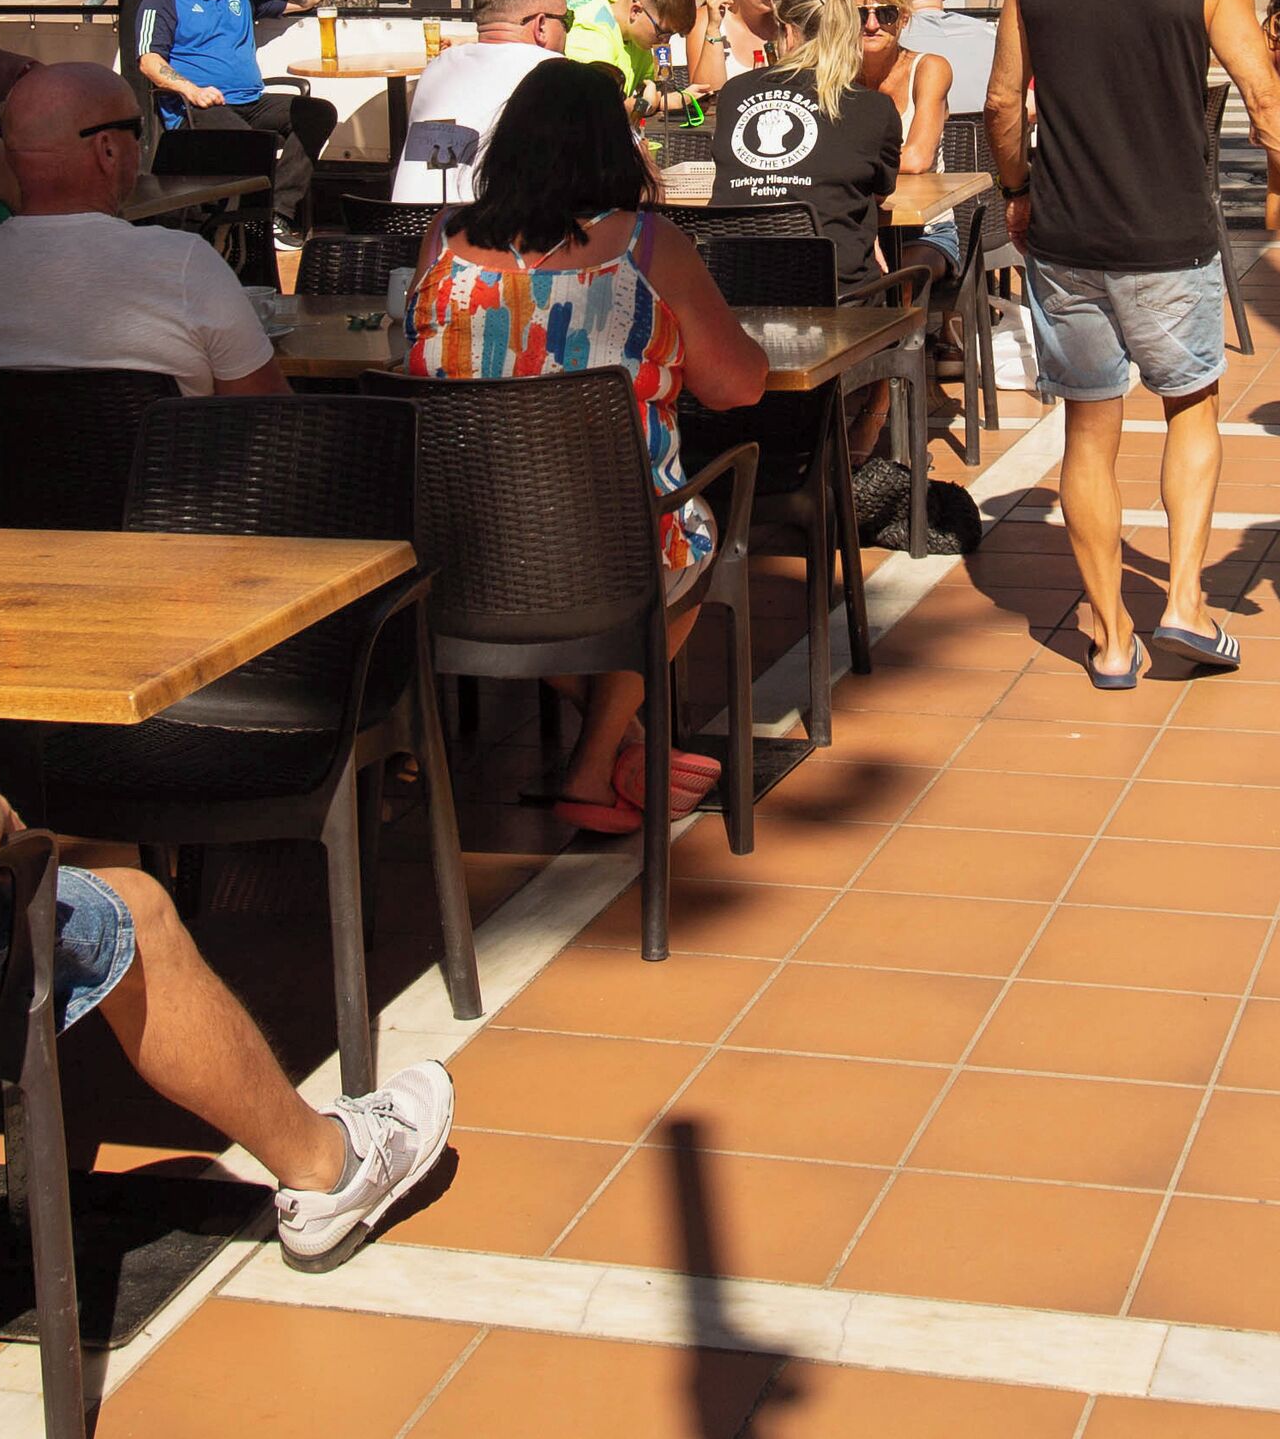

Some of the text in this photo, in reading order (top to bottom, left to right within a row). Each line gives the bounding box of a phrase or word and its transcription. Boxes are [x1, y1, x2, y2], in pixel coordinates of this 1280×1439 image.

[737, 103, 815, 130] NORTHERN SOUL
[736, 145, 809, 168] KEEP THE FAITH
[730, 176, 764, 188] Türkiye
[750, 186, 787, 197] Fethiye
